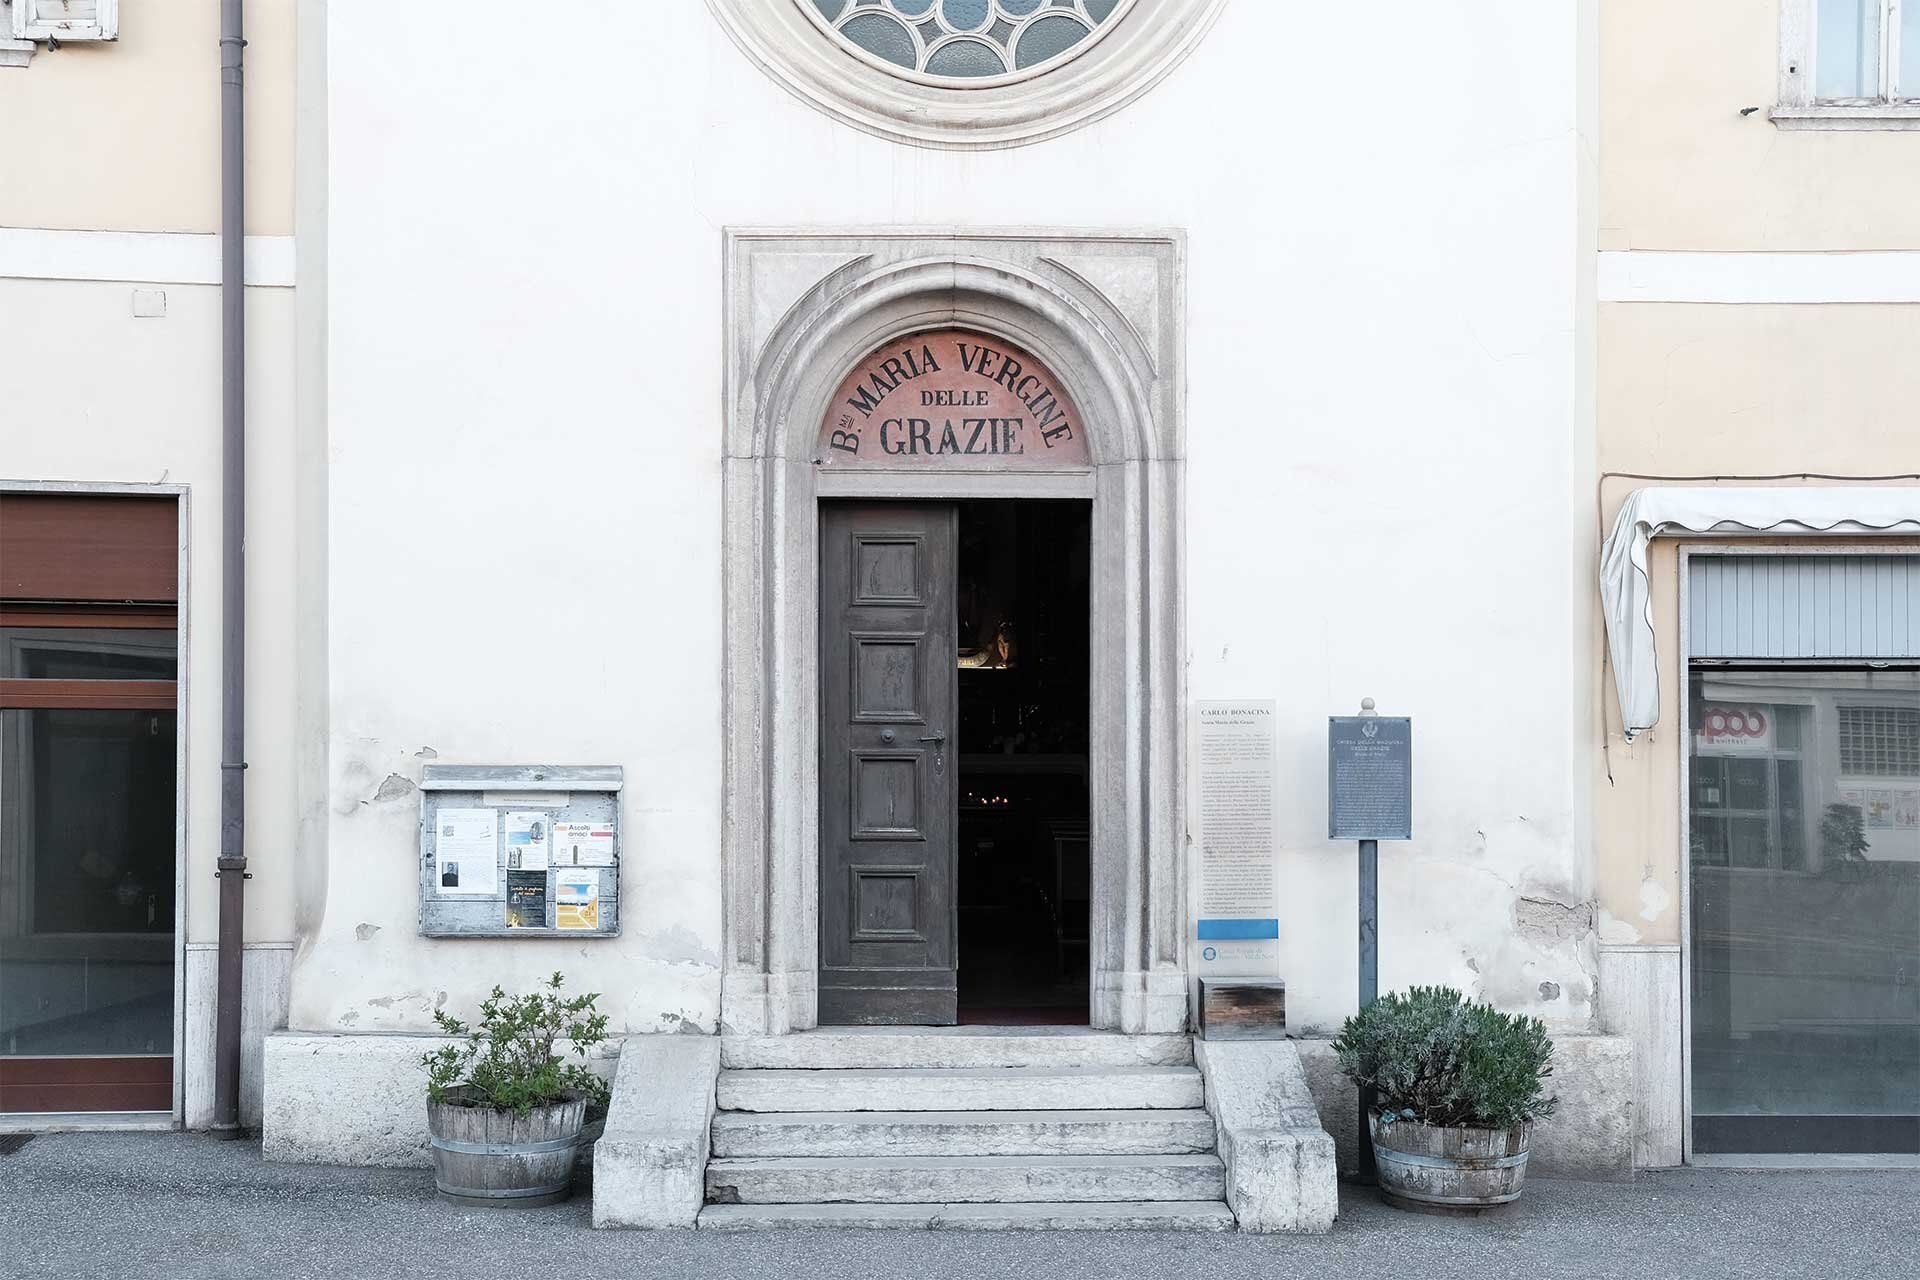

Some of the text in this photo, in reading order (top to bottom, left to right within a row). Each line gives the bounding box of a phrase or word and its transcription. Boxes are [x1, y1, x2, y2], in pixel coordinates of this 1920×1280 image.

[847, 344, 942, 419] MARIA
[956, 342, 1073, 449] VERGINE
[920, 390, 989, 406] DELLE
[880, 418, 1024, 455] GRAZIE
